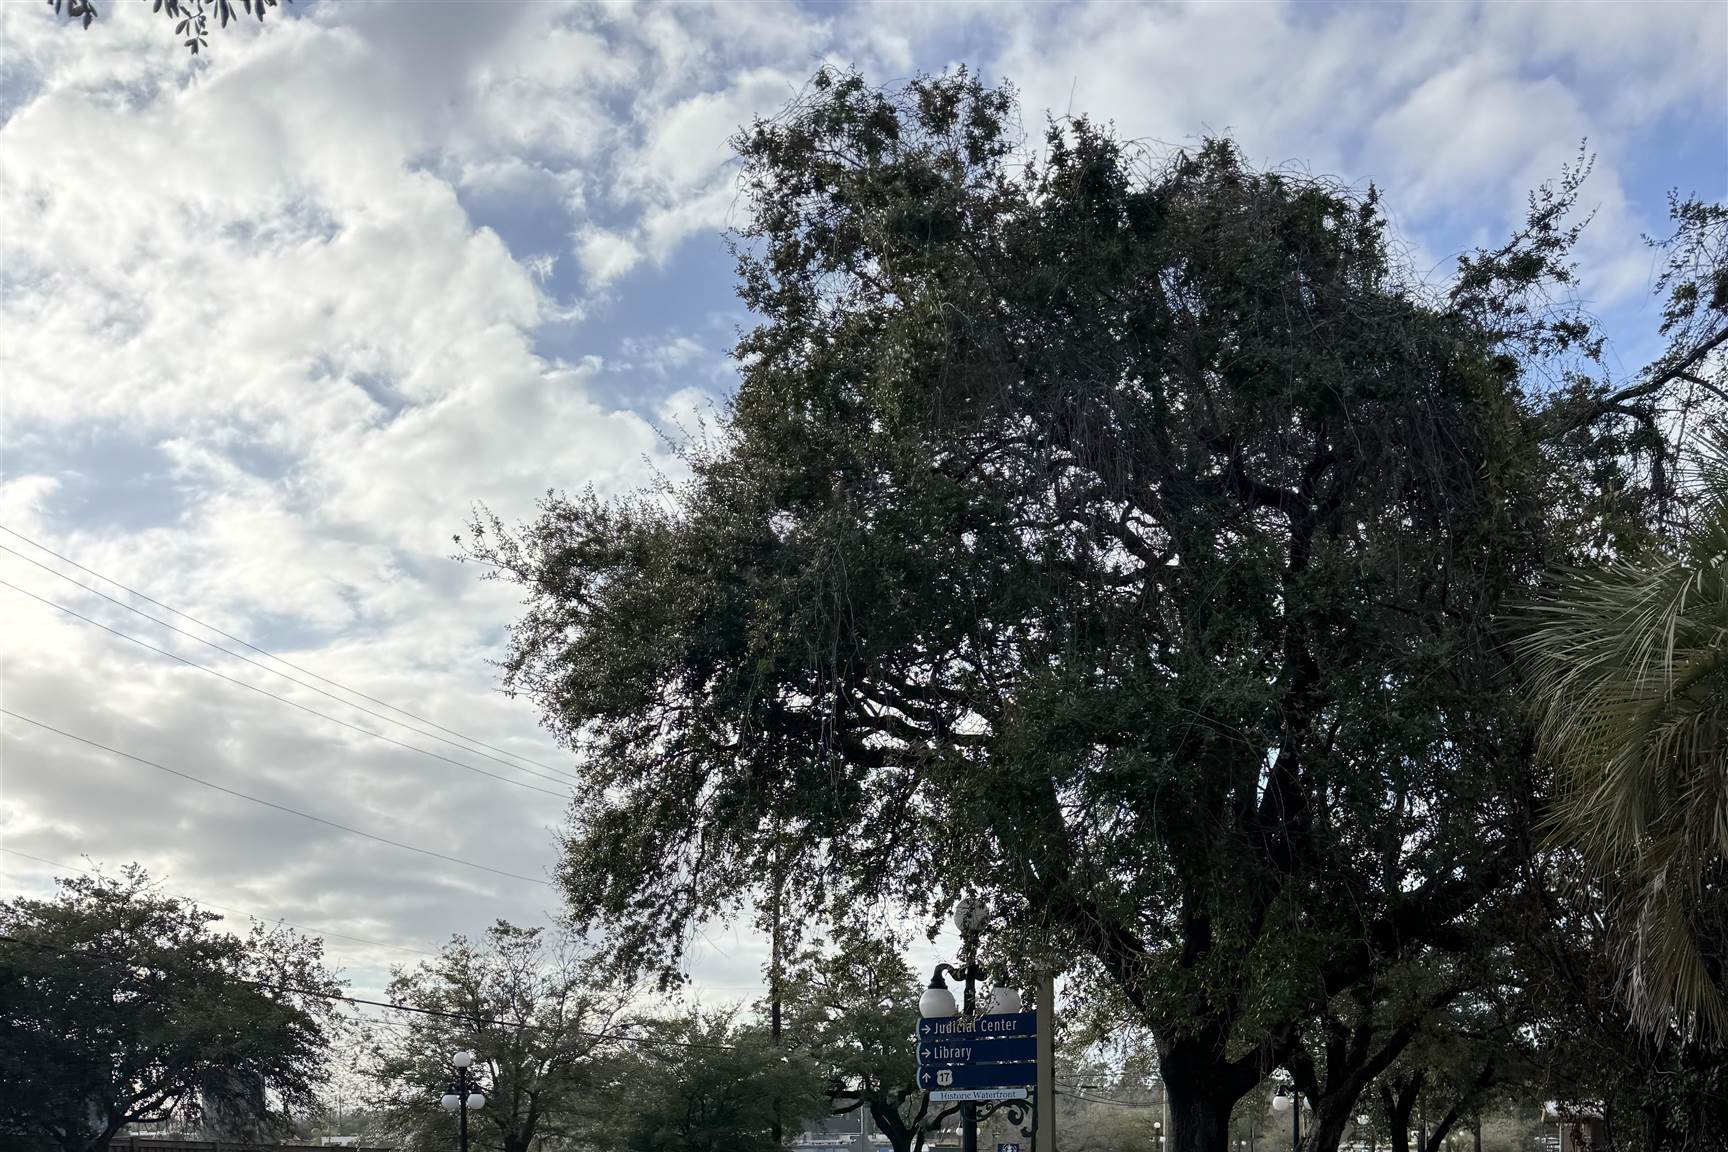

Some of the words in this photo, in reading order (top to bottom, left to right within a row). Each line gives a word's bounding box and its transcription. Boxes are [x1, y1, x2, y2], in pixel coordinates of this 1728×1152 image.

[934, 1020, 976, 1034] Judicial
[981, 1019, 1017, 1032] Center
[934, 1046, 972, 1061] Library
[940, 1073, 950, 1082] 17
[941, 1092, 971, 1100] Historic
[973, 1091, 1017, 1099] Waterfront
